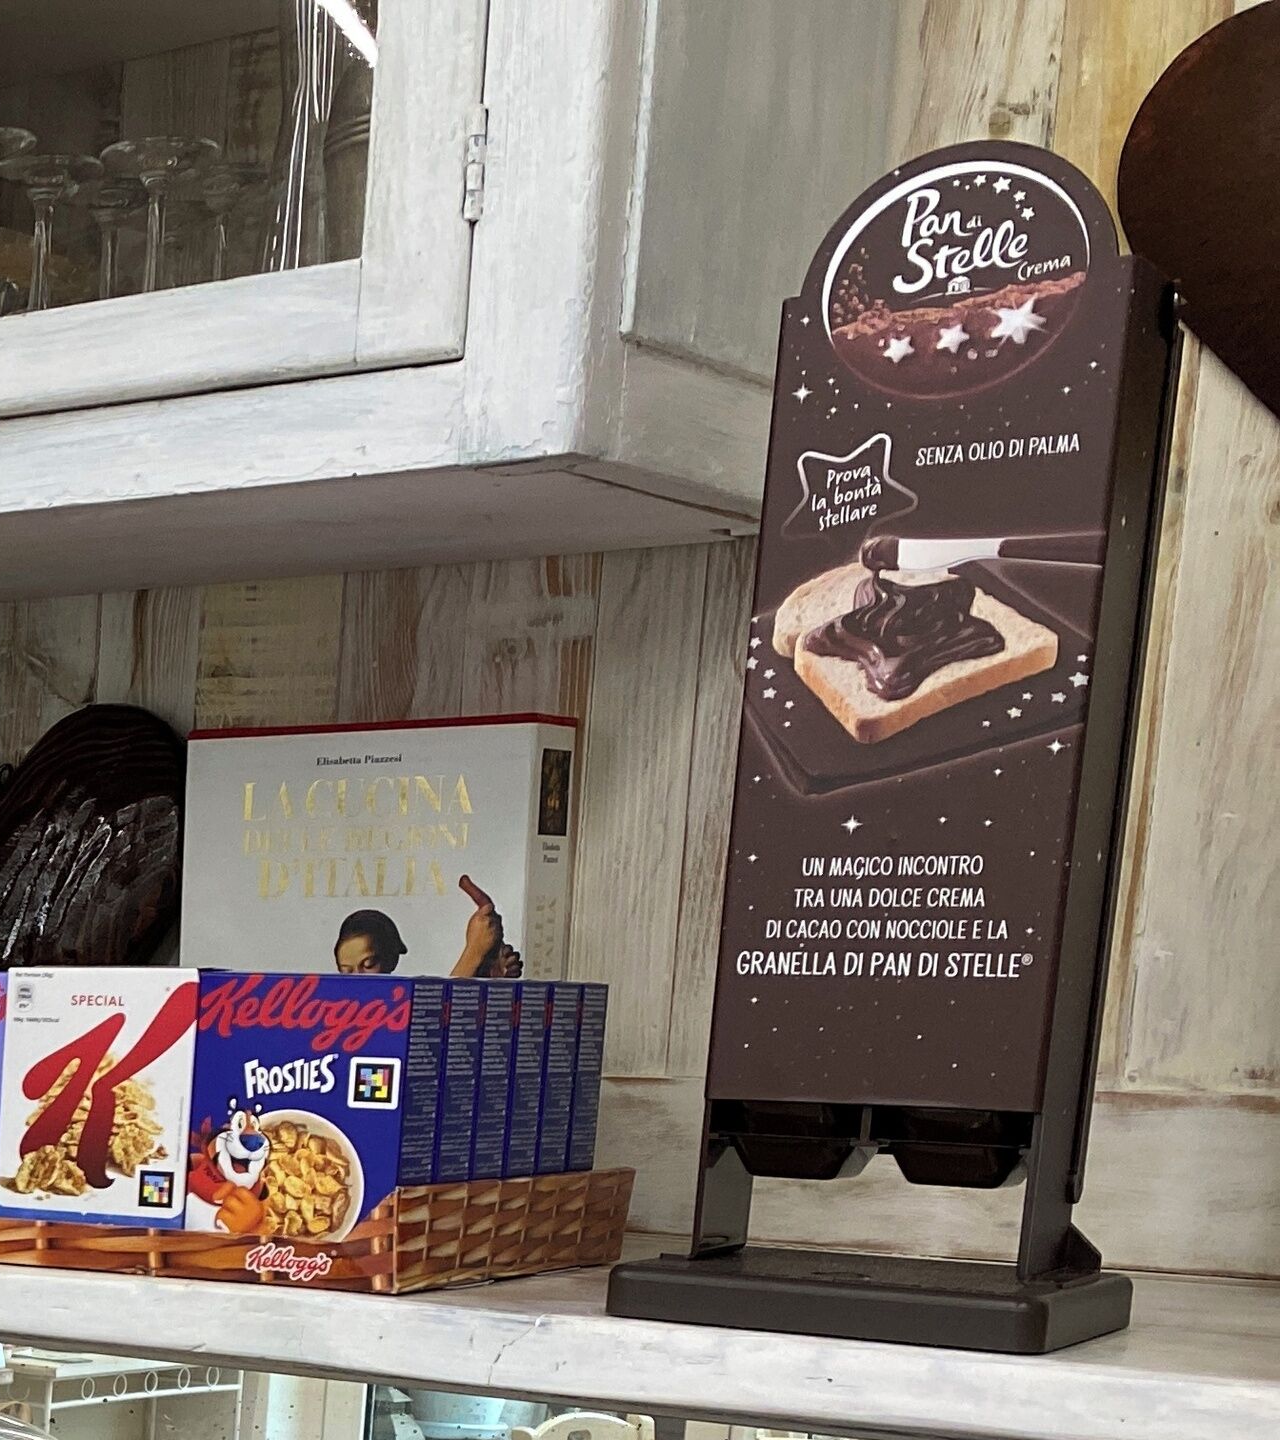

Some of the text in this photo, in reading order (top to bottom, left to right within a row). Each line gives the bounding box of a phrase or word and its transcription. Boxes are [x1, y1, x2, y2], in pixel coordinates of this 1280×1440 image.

[901, 188, 983, 248] Pan di
[893, 220, 1029, 294] Stelle
[1017, 254, 1072, 282] Crema
[915, 433, 1080, 466] SENZA OLIO DI PALMA
[826, 464, 871, 490] Prova
[811, 478, 882, 512] la bontà
[818, 502, 878, 531] stellare
[316, 753, 402, 767] Elisabetta Piazzesi
[243, 773, 474, 821] LA CUCINA
[257, 856, 447, 898] D'ITALIA
[802, 855, 984, 880] UN MAGICO INCONTRO
[793, 887, 985, 908] TRA UNA DOLCE CREMA
[765, 920, 1008, 939] DI CACAO CON NOCCIOLE E LA
[736, 951, 837, 976] GRANELLA
[843, 951, 864, 976] DI
[869, 952, 913, 977] PAN
[918, 952, 938, 977] DI
[70, 994, 125, 1008] SPECIAL
[198, 973, 413, 1051] Kellogg's
[20, 981, 200, 1190] K
[243, 1053, 336, 1099] FROSTIES
[246, 1247, 331, 1279] Kellogg's
